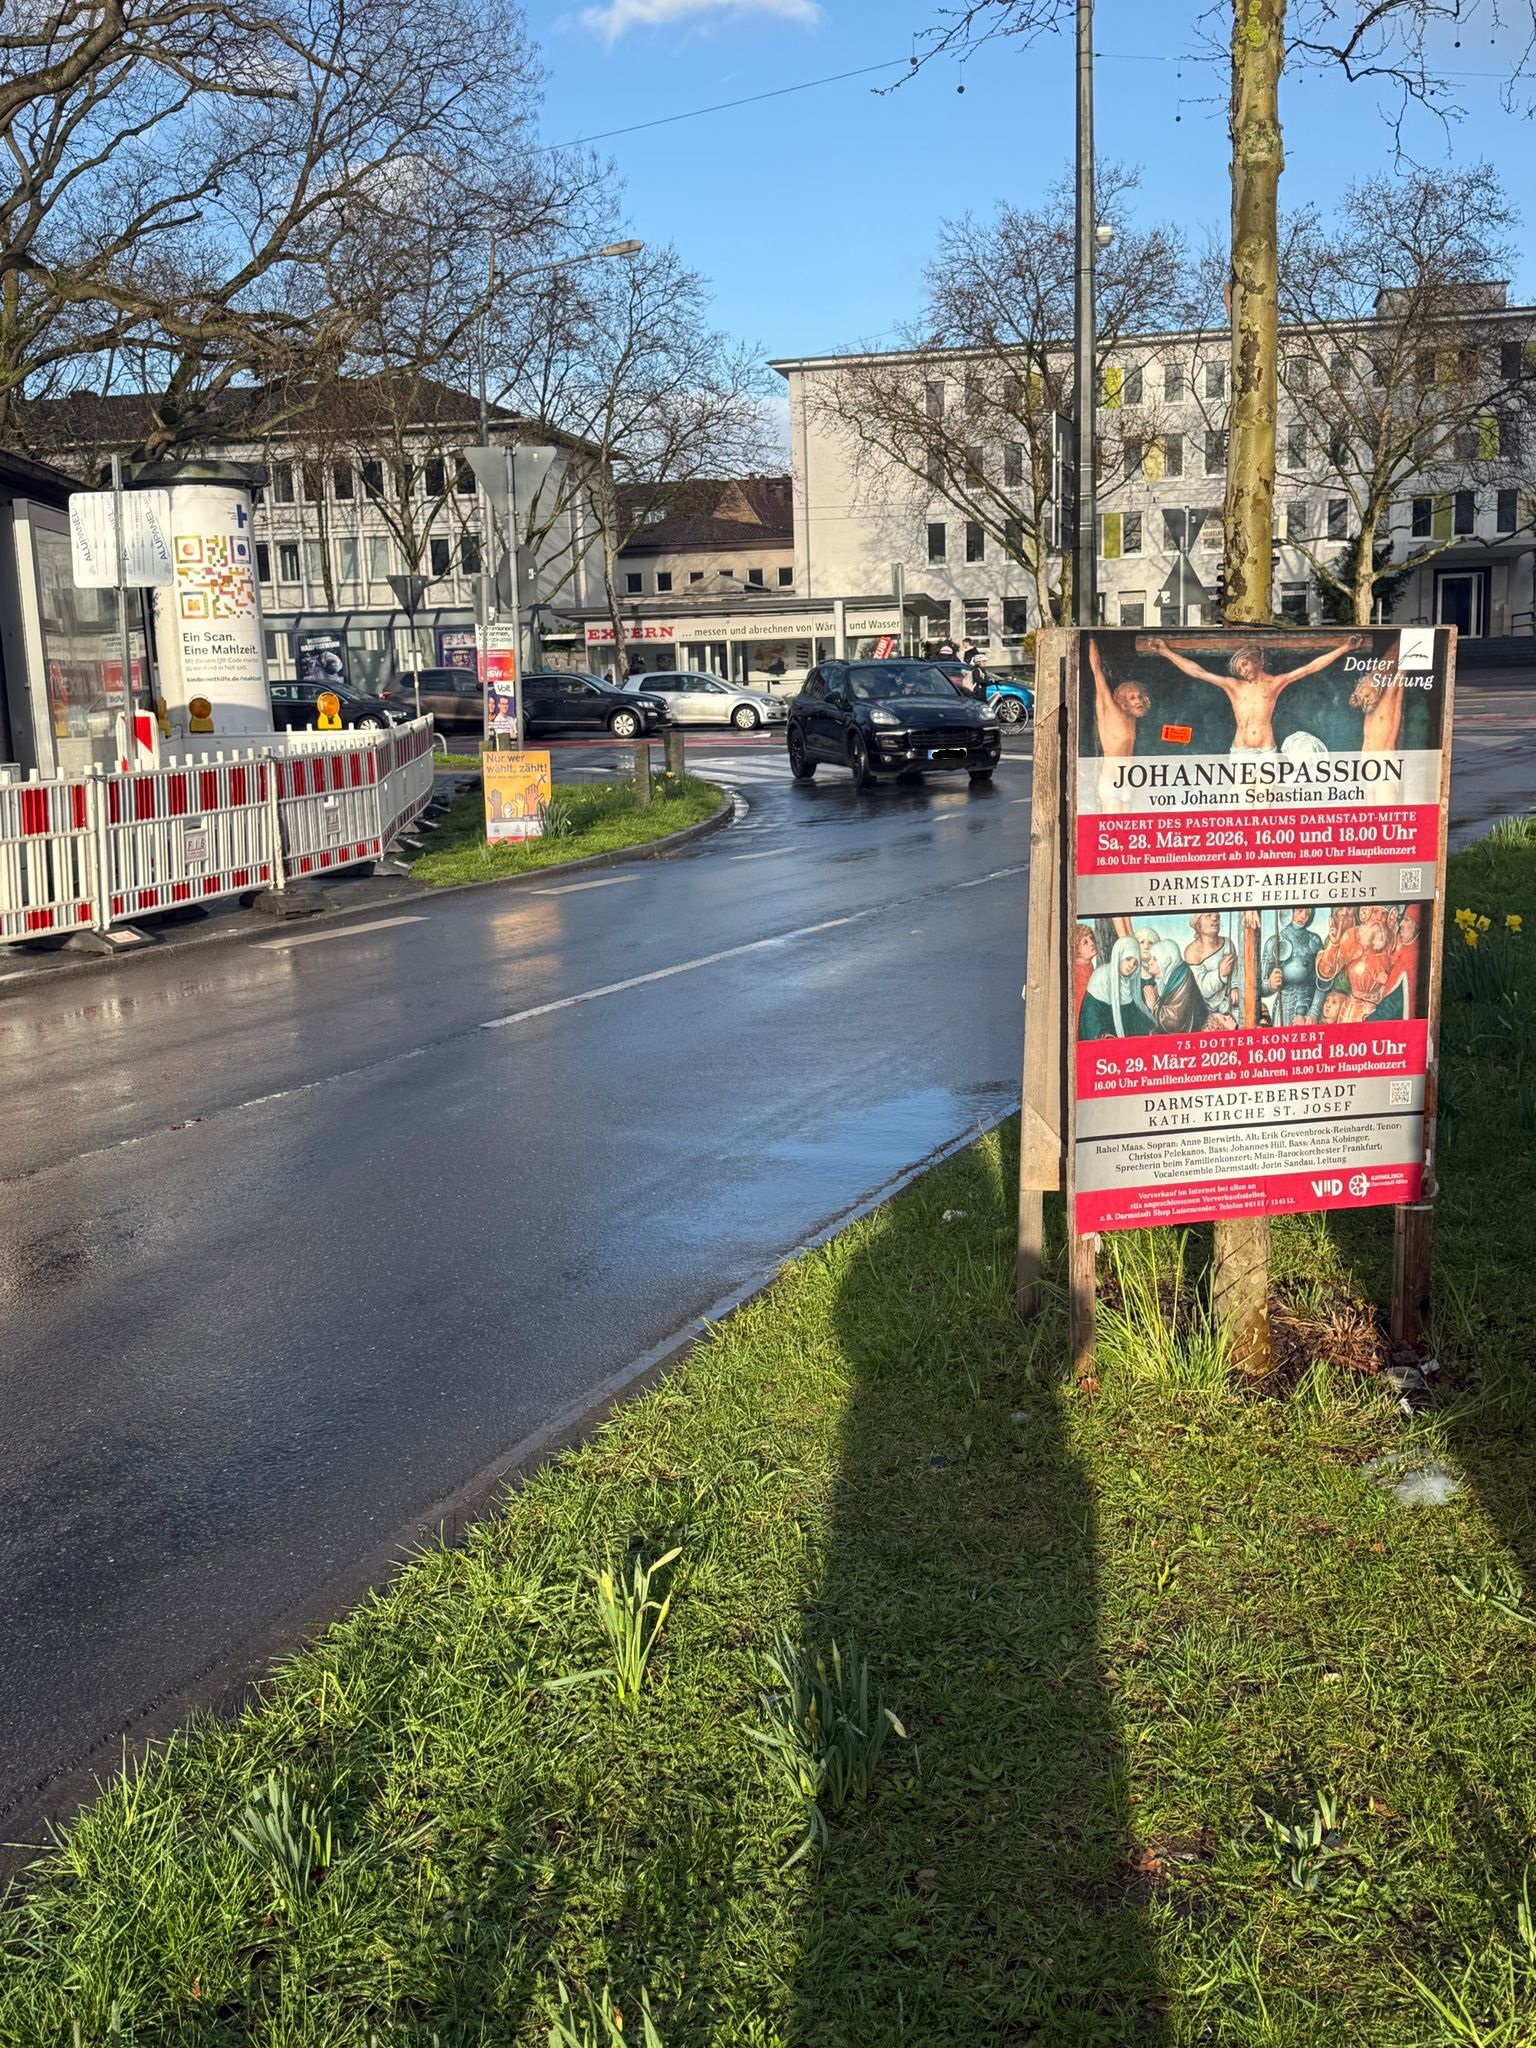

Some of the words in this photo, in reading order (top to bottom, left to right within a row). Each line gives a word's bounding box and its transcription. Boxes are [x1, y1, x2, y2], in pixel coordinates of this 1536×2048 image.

[183, 632, 200, 642] Ein
[204, 632, 236, 642] Scan.
[694, 628, 727, 636] messen
[730, 625, 746, 635] und
[748, 624, 794, 634] abrechnen
[795, 624, 812, 632] von
[815, 622, 836, 631] Wär
[850, 620, 867, 630] und
[868, 620, 900, 629] Wasser
[184, 645, 208, 655] Eine
[212, 644, 258, 654] Mahlzeit.
[1344, 656, 1394, 671] Dotter
[1371, 673, 1434, 690] Stiftung
[486, 754, 505, 763] Nur
[508, 754, 526, 762] wer
[486, 764, 516, 774] wählt,
[520, 764, 548, 772] zählt!
[1113, 759, 1404, 788] JOHANNESPASSION
[1149, 795, 1176, 806] von
[1181, 790, 1240, 805] Johann
[1245, 788, 1323, 803] Sebastian
[1328, 786, 1366, 800] Bach
[1099, 819, 1154, 831] KONZERT
[1158, 818, 1182, 830] DES
[1186, 815, 1296, 828] PASTORALRAUMS
[1300, 812, 1416, 824] DARMSTADT-MITTE
[1098, 834, 1124, 851] Sa,
[1128, 834, 1152, 849] 28.
[1156, 832, 1201, 848] März
[1206, 831, 1248, 846] 2026,
[1255, 830, 1295, 844] 16.00
[1300, 827, 1332, 843] und
[1338, 827, 1378, 842] 18.00
[1382, 824, 1418, 840] Uhr
[1096, 856, 1119, 866] 16.00
[1121, 854, 1140, 865] Uhr
[1144, 852, 1226, 864] Familienkonzert
[1229, 851, 1242, 860] ab
[1245, 851, 1256, 860] 10
[1300, 848, 1323, 858] 18.00
[1325, 847, 1345, 857] Uhr
[1348, 845, 1416, 858] Hauptkonzert
[1150, 870, 1363, 892] DARMSTADT-ARHEILGEN
[1135, 895, 1183, 907] KATH.
[1192, 892, 1253, 904] KIRCHE
[1262, 889, 1320, 902] HEILIG
[1328, 887, 1378, 899] GEIST
[1177, 1041, 1196, 1050] 75.
[1199, 1032, 1325, 1049] DOTTER-KONZERT
[1096, 1058, 1121, 1076] So,
[1126, 1058, 1148, 1072] 29.
[1152, 1054, 1196, 1071] März
[1201, 1051, 1242, 1067] 2026,
[1248, 1048, 1286, 1064] 16.00
[1290, 1044, 1322, 1060] und
[1329, 1043, 1368, 1058] 18.00
[1372, 1039, 1406, 1056] Uhr
[1094, 1080, 1117, 1091] 16.00
[1118, 1078, 1138, 1089] Uhr
[1141, 1073, 1222, 1087] Familienkonzert
[1224, 1070, 1236, 1080] ab
[1240, 1070, 1250, 1078] 10
[1292, 1066, 1314, 1076] 18.00
[1316, 1064, 1336, 1074] Uhr
[1338, 1060, 1406, 1073] Hauptkonzert
[1144, 1084, 1357, 1112] DARMSTADT-EBERSTADT
[1149, 1114, 1196, 1127] KATH.
[1204, 1108, 1265, 1122] KIRCHE
[1273, 1106, 1296, 1117] ST.
[1304, 1101, 1352, 1114] JOSEF
[1096, 1144, 1120, 1154] Rahel
[1180, 1138, 1201, 1146] Anne
[1262, 1131, 1278, 1140] Erik
[1129, 1152, 1162, 1161] Christos
[1230, 1144, 1268, 1152] Johannes
[1310, 1138, 1330, 1146] Anna
[1116, 1162, 1160, 1173] Sprecherin
[1162, 1160, 1182, 1168] beim
[1254, 1146, 1340, 1160] Main-Barockorchester
[1154, 1166, 1213, 1178] Vocalensemble
[1317, 1156, 1347, 1165] Leitung
